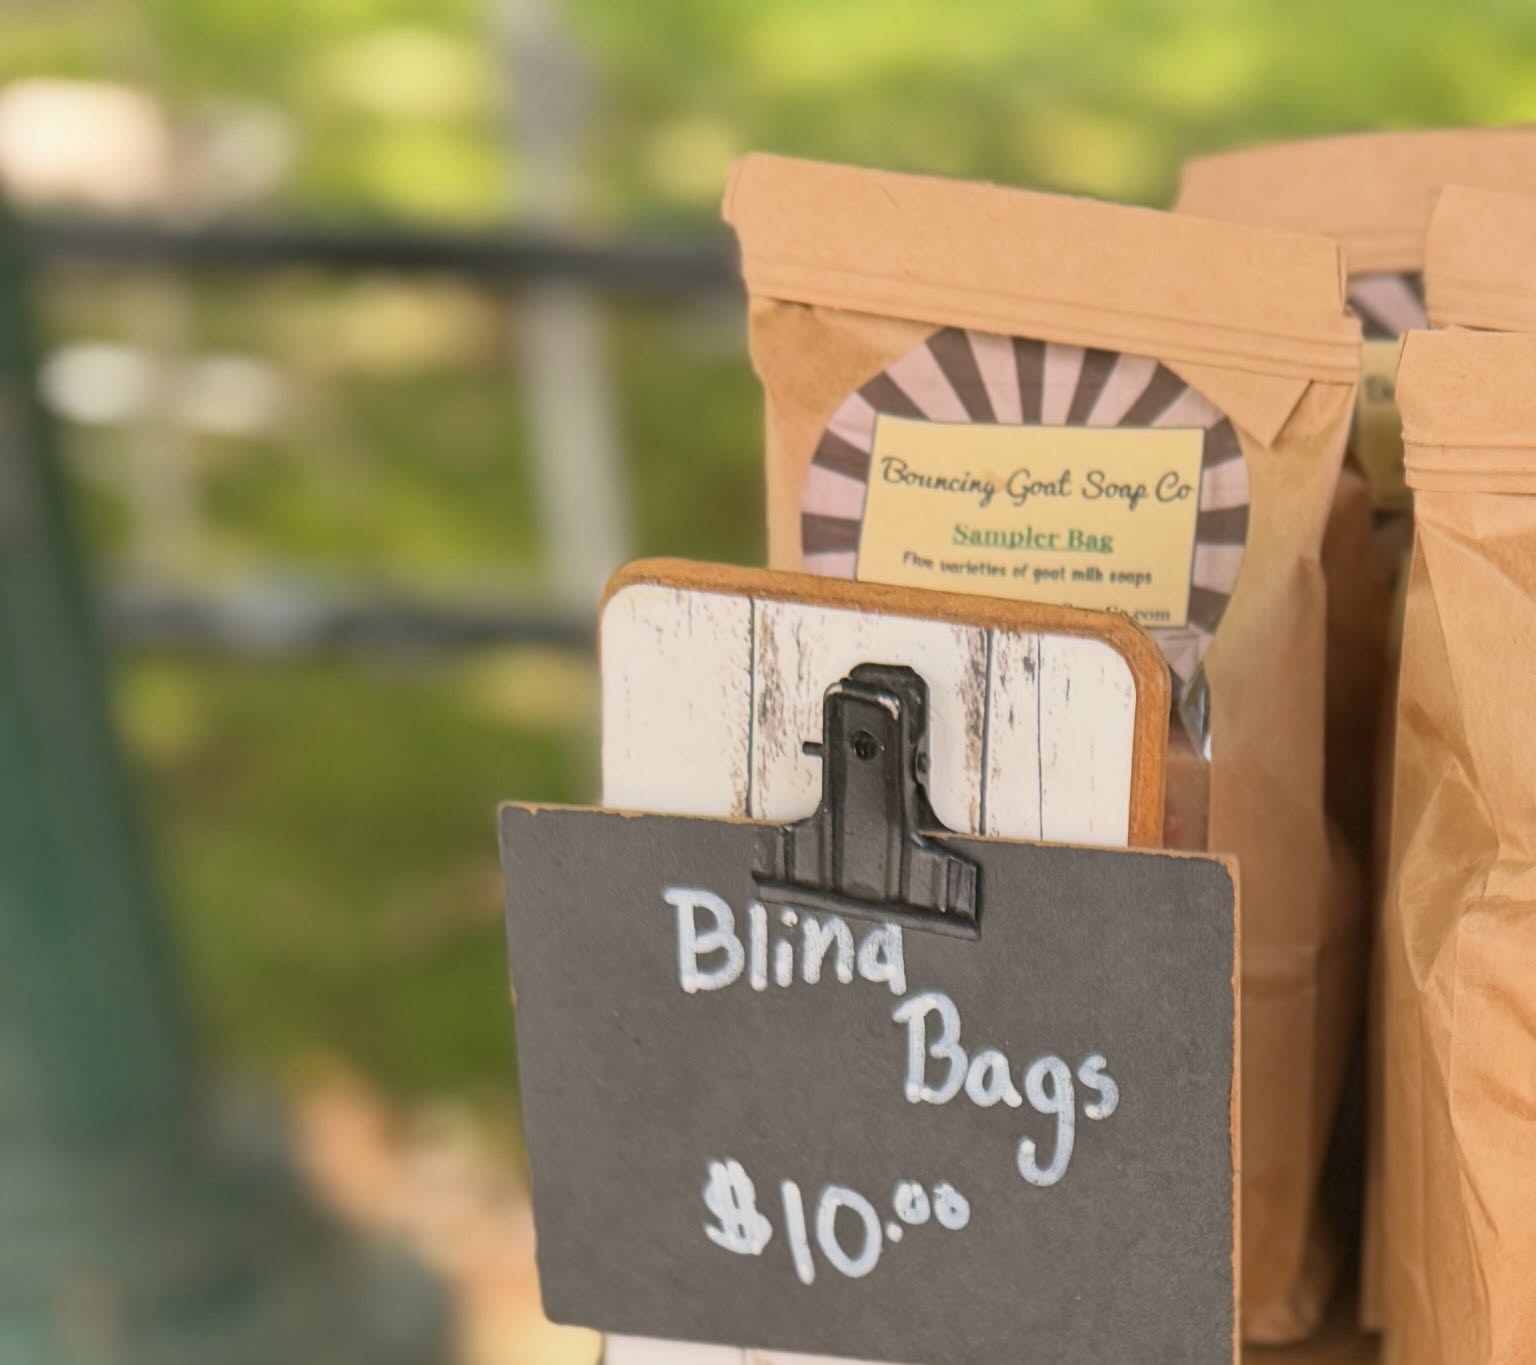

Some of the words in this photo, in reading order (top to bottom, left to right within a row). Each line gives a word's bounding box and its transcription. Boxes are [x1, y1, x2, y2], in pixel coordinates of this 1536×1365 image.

[881, 457, 996, 507] Bouncing
[1006, 469, 1072, 506] Goat
[1082, 470, 1148, 511] Soap
[1156, 471, 1194, 503] Co
[952, 524, 1061, 552] Sampler
[1068, 529, 1114, 554] Bag
[894, 993, 1119, 1187] Bags
[704, 1158, 970, 1285] $10.00
